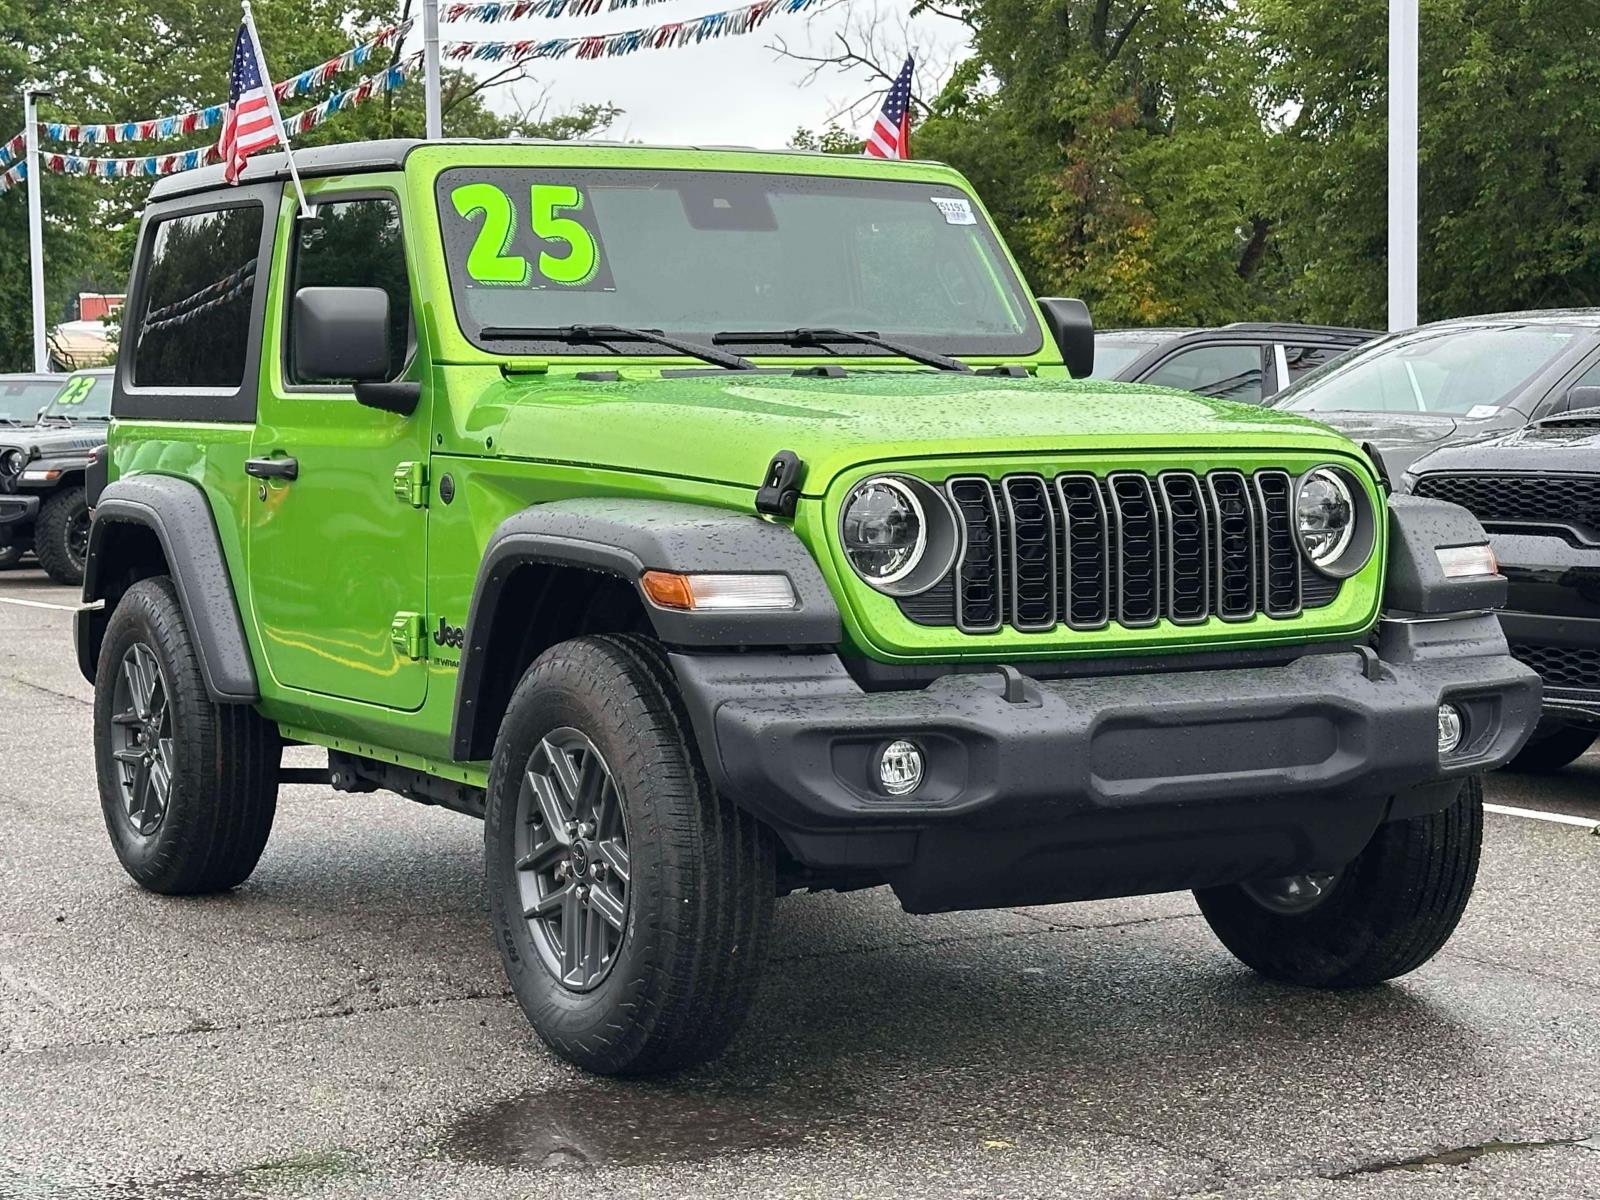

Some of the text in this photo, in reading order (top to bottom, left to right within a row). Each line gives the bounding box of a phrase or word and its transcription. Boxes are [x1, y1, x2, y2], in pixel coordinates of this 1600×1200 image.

[450, 182, 600, 287] 25
[57, 376, 97, 405] 23
[433, 616, 464, 650] Jee
